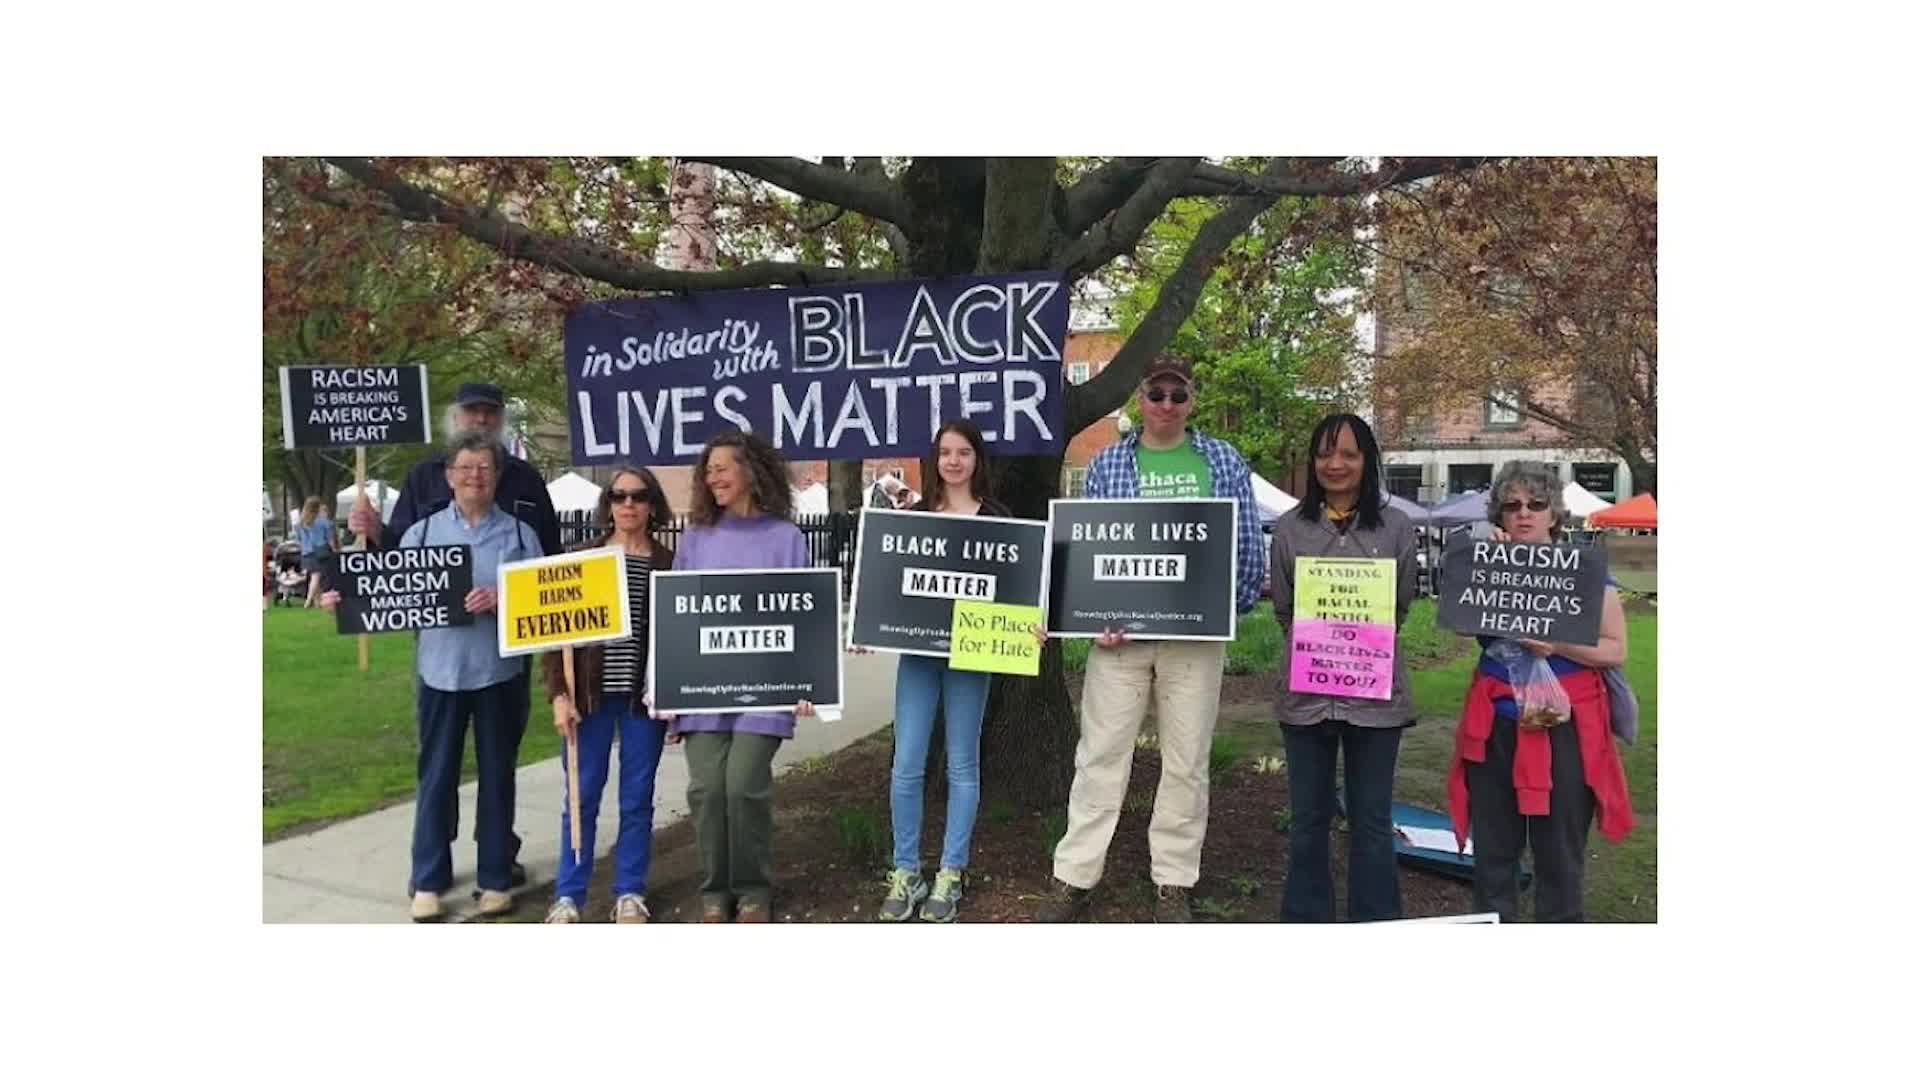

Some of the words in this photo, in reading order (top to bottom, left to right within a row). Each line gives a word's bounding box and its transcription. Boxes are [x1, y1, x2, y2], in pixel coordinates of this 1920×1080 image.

[581, 346, 612, 378] in
[616, 318, 760, 371] Solidarity
[713, 340, 781, 380] with
[788, 281, 1060, 373] BLACK
[311, 368, 398, 388] RACISM
[314, 392, 327, 405] IS
[330, 390, 399, 405] BREAKING
[308, 406, 408, 424] AMERICA'S
[577, 385, 751, 456] LIVES
[772, 370, 1053, 449] MATTER
[329, 425, 389, 442] HEART
[1139, 471, 1197, 488] thaca
[1071, 522, 1136, 541] BLACK
[1151, 522, 1208, 541] LIVES
[881, 533, 948, 557] BLACK
[962, 540, 1019, 563] LIVES
[1473, 541, 1580, 570] RACISM
[339, 546, 464, 573] IGNORING
[1101, 558, 1178, 577] MATTER
[357, 571, 449, 595] RACISM
[538, 563, 583, 584] RACISM
[910, 572, 989, 596] MATTER
[1308, 568, 1382, 579] STANDING
[1471, 569, 1486, 584] IS
[1491, 571, 1575, 591] BREAKING
[539, 584, 583, 606] HARMS
[1330, 583, 1359, 594] FOR
[370, 593, 422, 609] MAKES
[425, 592, 439, 606] IT
[675, 594, 742, 614] BLACK
[757, 592, 814, 612] LIVES
[1317, 597, 1372, 609] RACIAL
[1458, 587, 1582, 615] AMERICA'S
[360, 606, 449, 631] WORSE
[516, 605, 611, 639] EVERYONE
[959, 611, 985, 630] No
[991, 615, 1036, 634] Place
[1480, 611, 1555, 635] HEART
[709, 630, 786, 649] MATTER
[959, 634, 986, 652] for
[992, 638, 1033, 657] Hate
[1331, 629, 1356, 641] DO
[1296, 642, 1346, 655] BLACK
[1348, 645, 1391, 659] LIVES
[1311, 657, 1374, 672] MATTER
[1308, 671, 1329, 683] TO
[1333, 674, 1376, 688] YOU?
